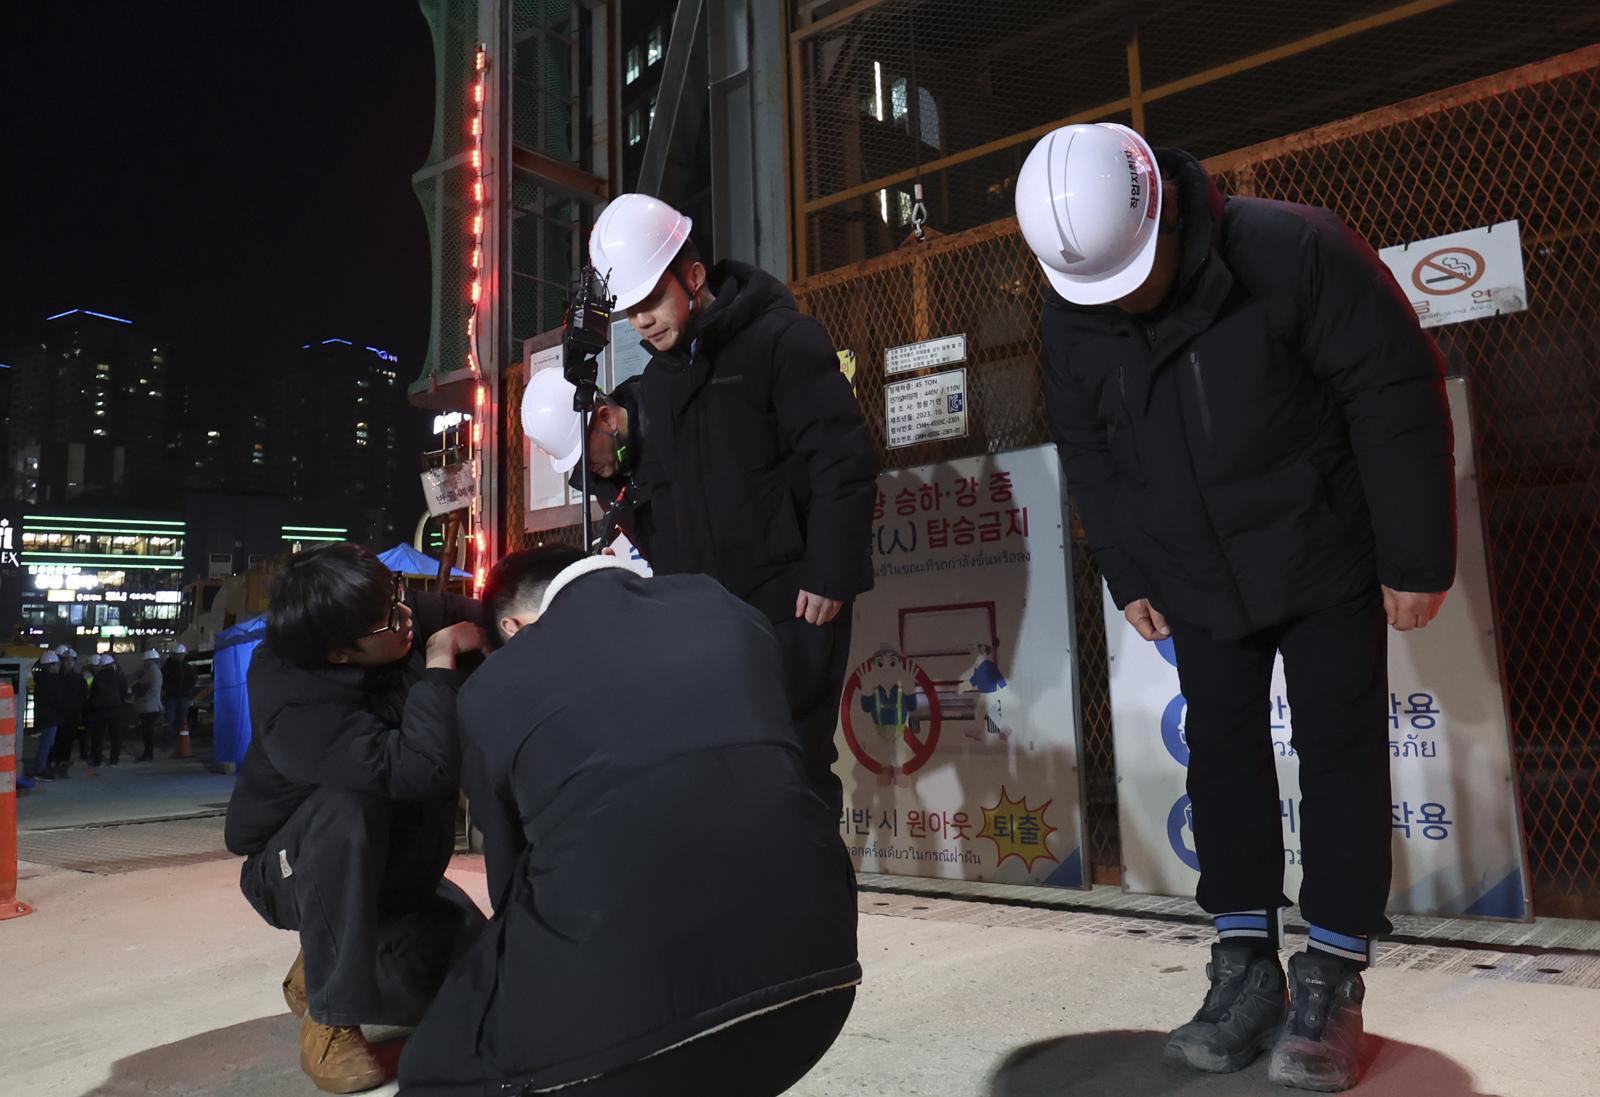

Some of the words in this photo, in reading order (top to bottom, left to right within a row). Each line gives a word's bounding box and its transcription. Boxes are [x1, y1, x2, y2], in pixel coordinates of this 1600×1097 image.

[989, 471, 1013, 503] 중
[927, 507, 1029, 549] 탑승금지
[879, 808, 898, 837] 시
[906, 810, 973, 840] 원아웃
[993, 813, 1040, 846] 퇴출
